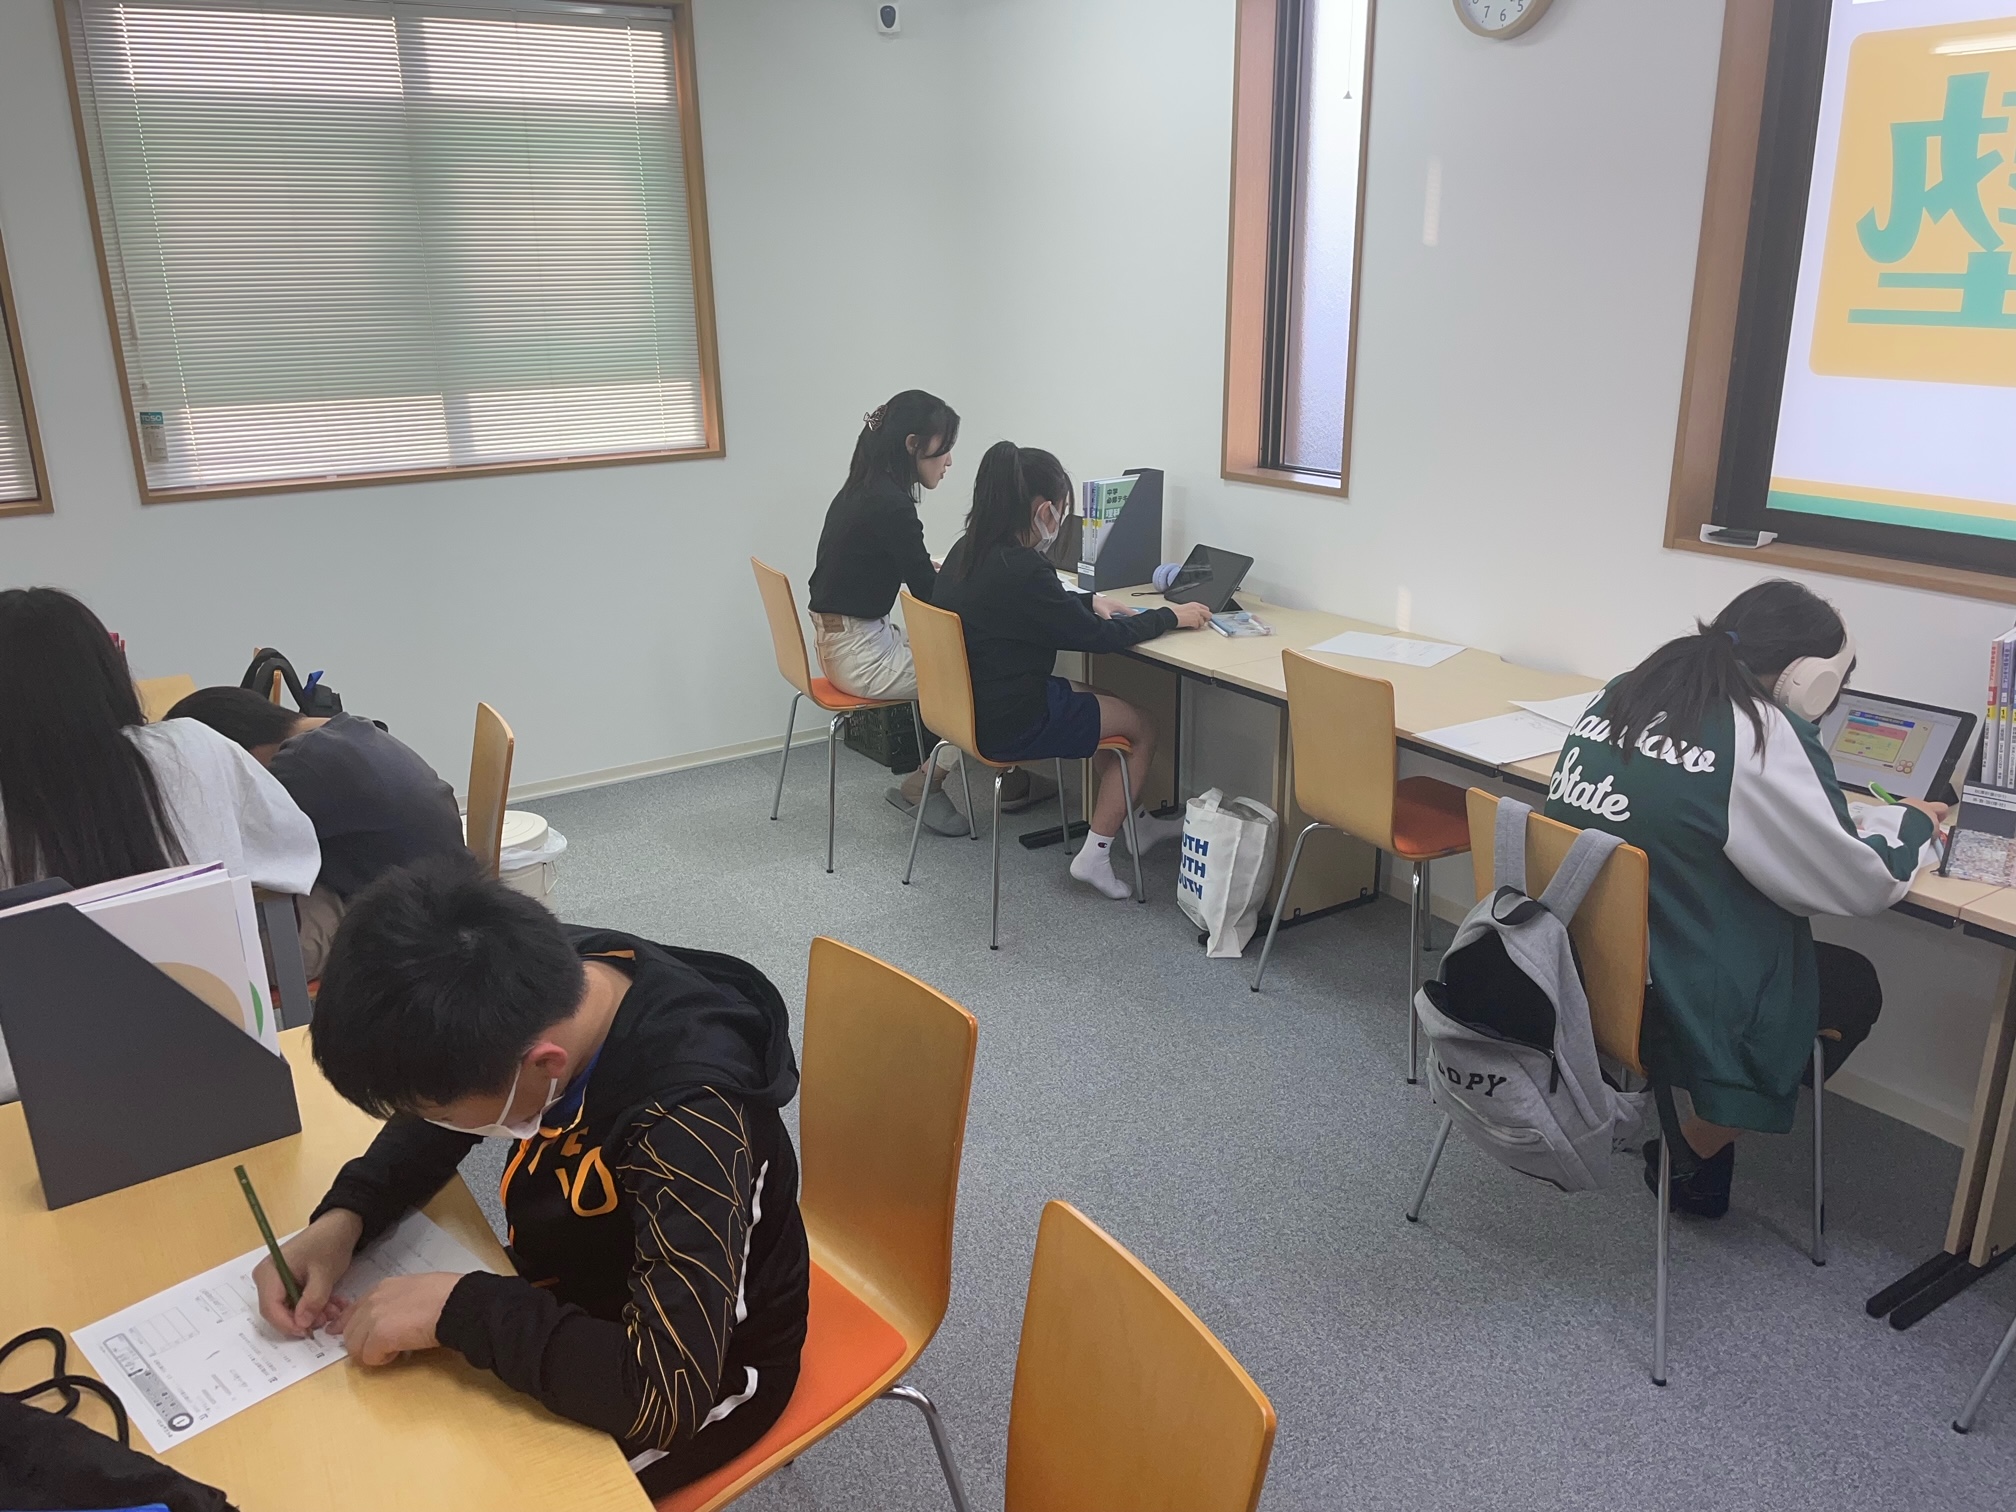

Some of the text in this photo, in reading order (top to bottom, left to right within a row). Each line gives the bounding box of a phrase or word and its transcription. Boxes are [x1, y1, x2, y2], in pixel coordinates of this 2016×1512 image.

[1484, 6, 1490, 18] 7
[1500, 8, 1507, 21] 6
[1547, 746, 1631, 822] State
[1178, 872, 1203, 900] UTH
